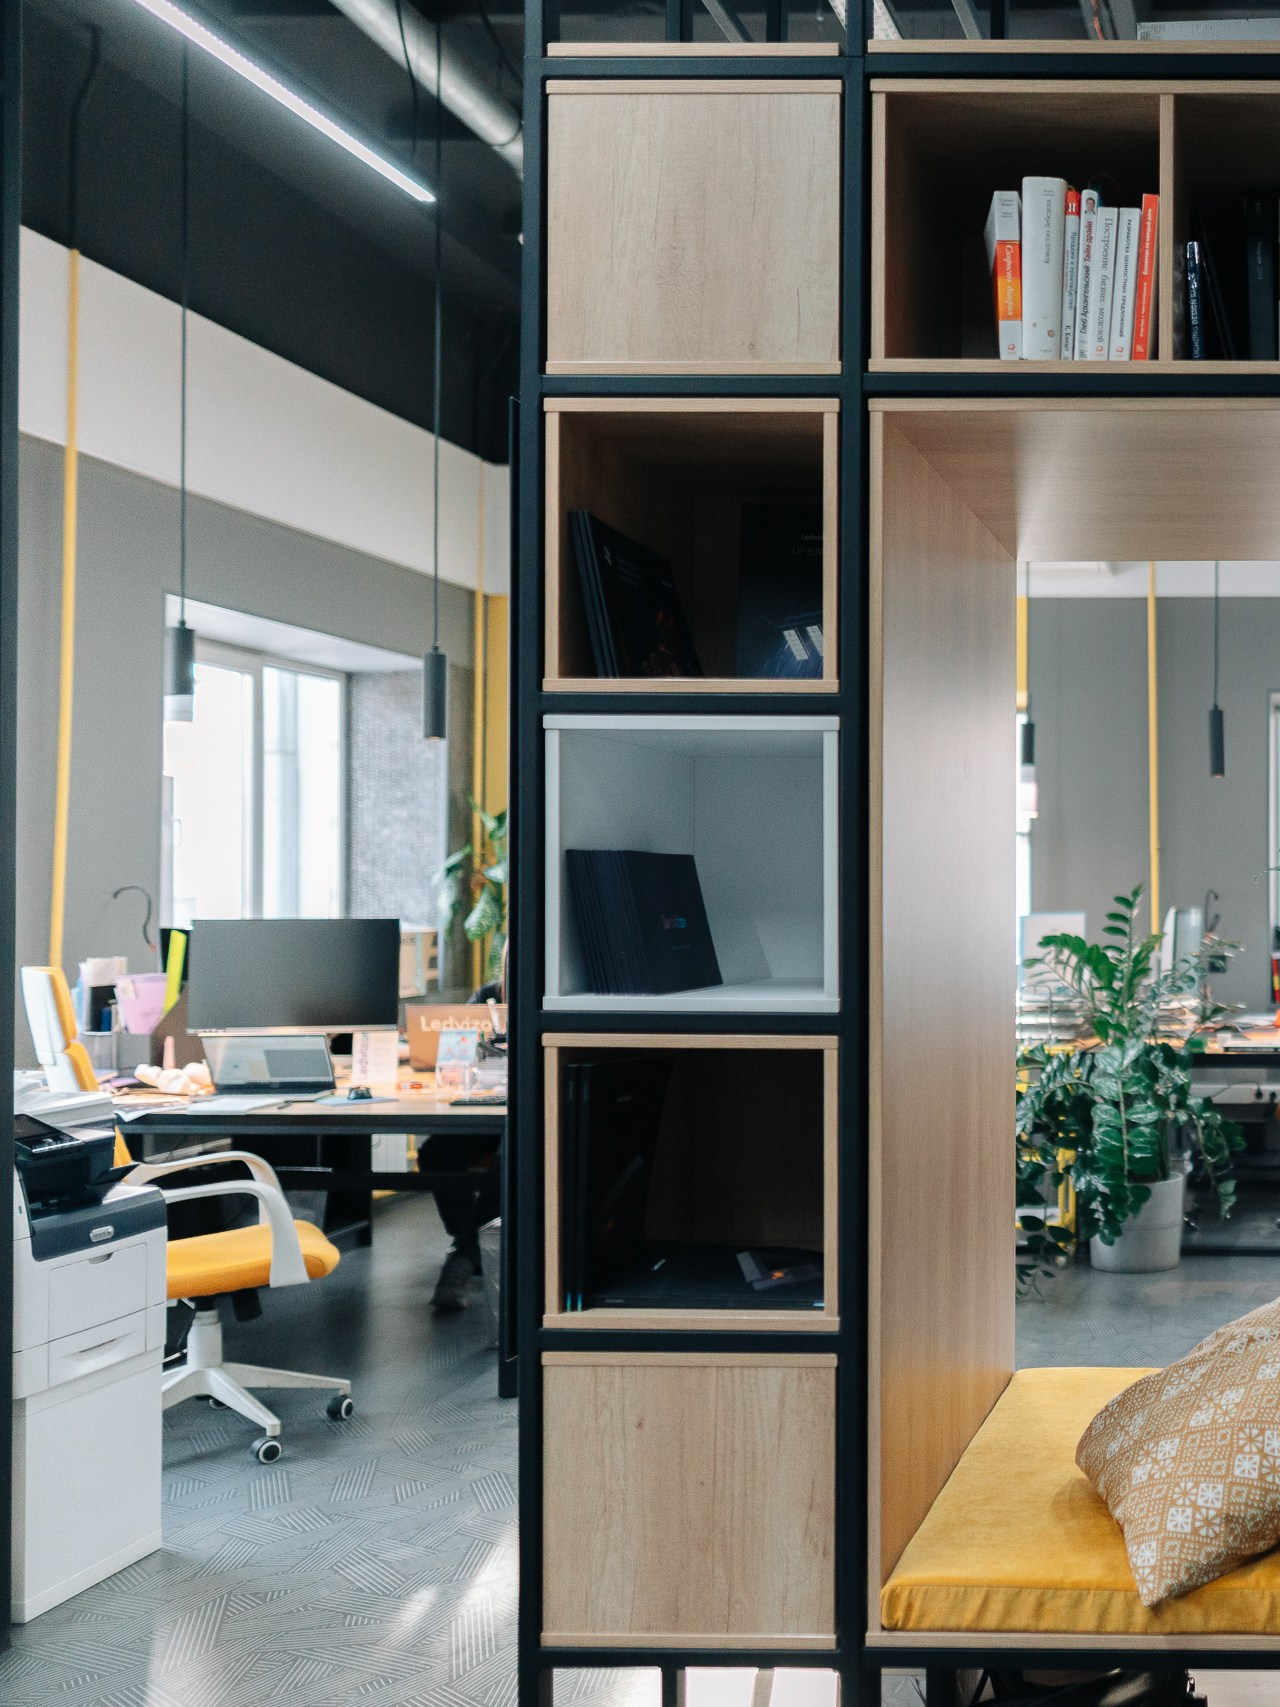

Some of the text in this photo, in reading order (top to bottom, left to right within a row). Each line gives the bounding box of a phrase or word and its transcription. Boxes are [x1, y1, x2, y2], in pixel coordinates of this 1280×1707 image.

[1124, 218, 1132, 253] РАЗРАБОТКА
[1003, 245, 1014, 283] Скорость
[1095, 217, 1113, 343] Построение бизнес-моделей
[1080, 265, 1091, 318] Архангельский
[1189, 299, 1199, 325] DESIGN
[1191, 325, 1200, 358] LIGHTING
[420, 1014, 494, 1031] Ledvizo
